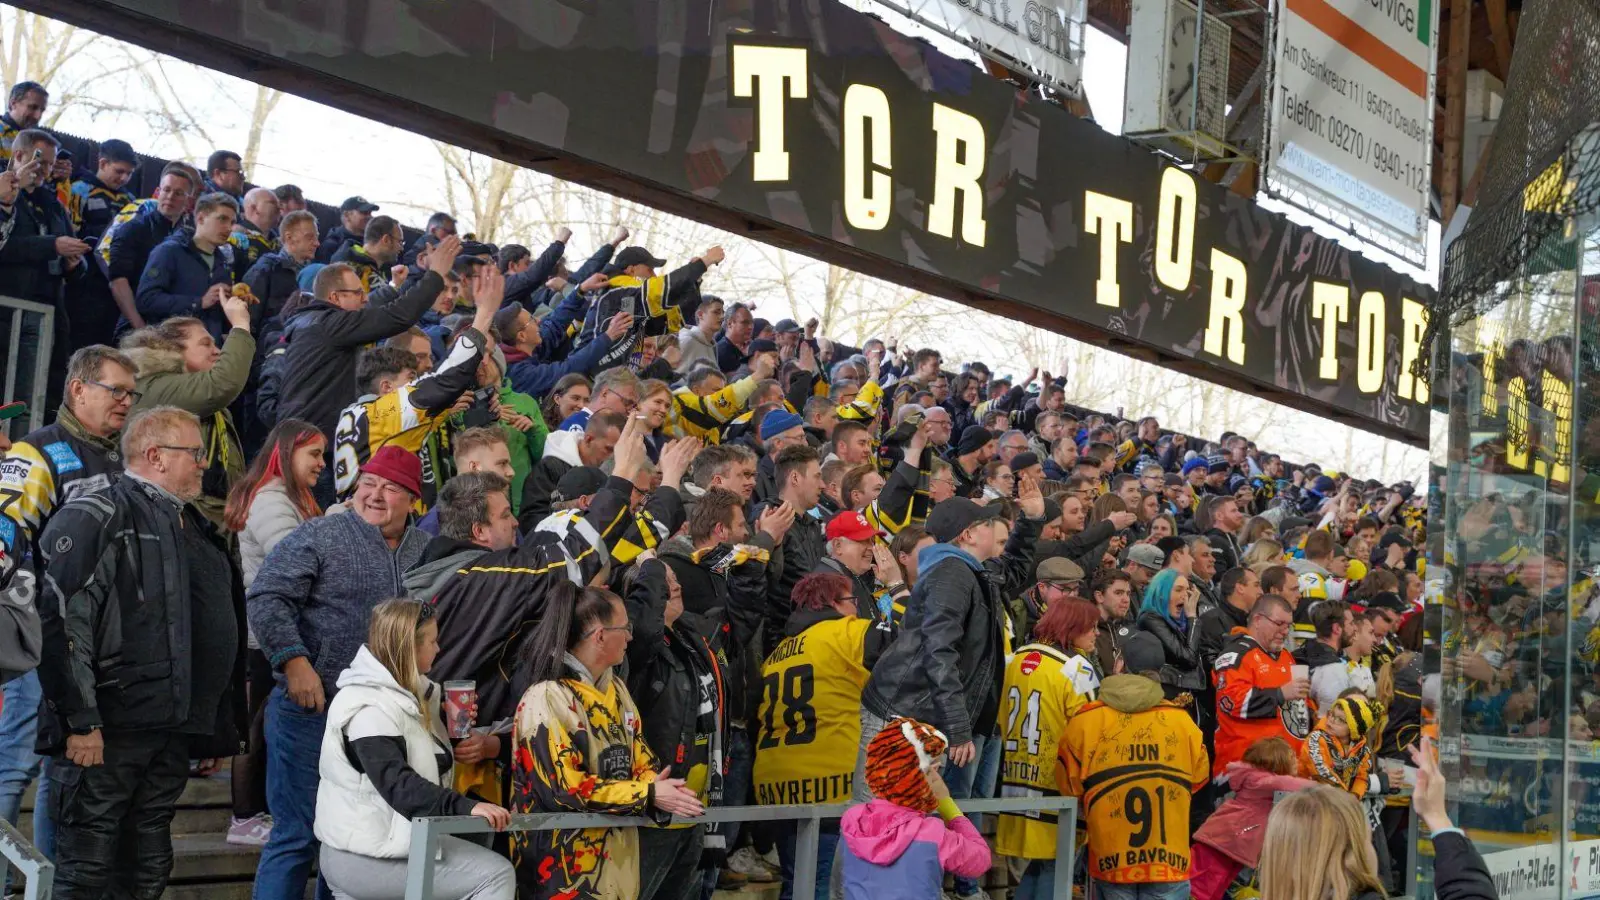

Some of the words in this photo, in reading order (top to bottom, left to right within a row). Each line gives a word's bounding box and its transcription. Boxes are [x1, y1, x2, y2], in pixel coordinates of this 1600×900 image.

[1283, 37, 1298, 66] Am
[1301, 47, 1346, 96] Steinkreuz
[1349, 80, 1358, 104] 11
[1367, 90, 1392, 125] 95473
[1280, 84, 1325, 137] Telefon:
[1328, 115, 1364, 160] 09270
[1374, 142, 1424, 194] 9940-112
[1085, 166, 1248, 365] TOR
[1005, 685, 1042, 755] 24
[1128, 743, 1160, 761] JUN
[1124, 785, 1168, 848] 91
[1098, 853, 1120, 872] ESV
